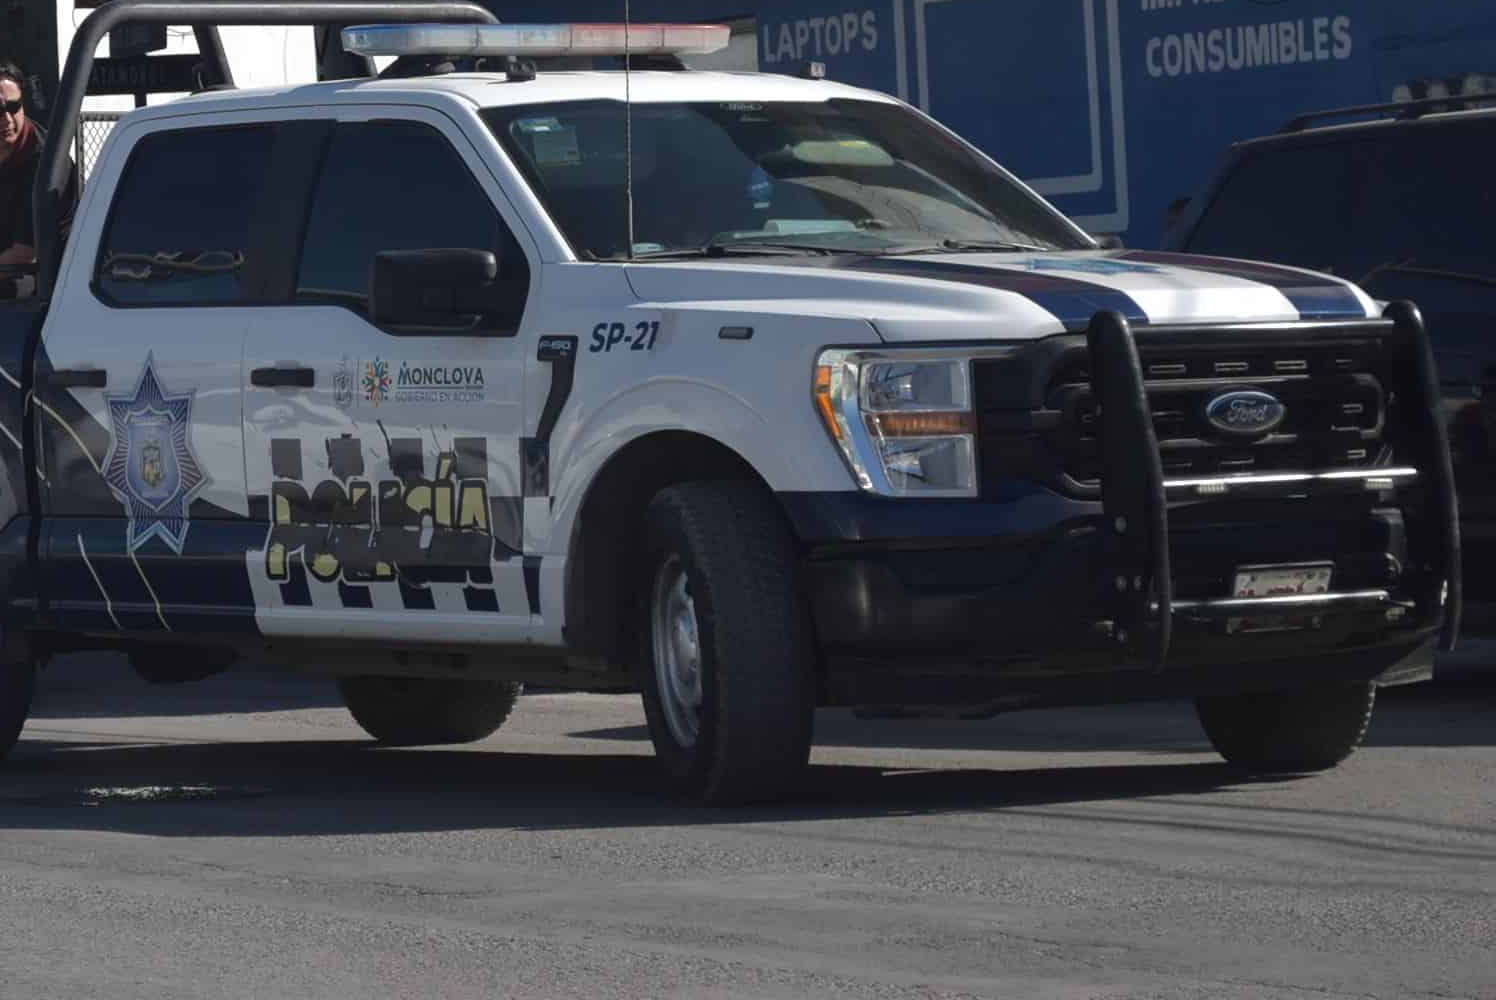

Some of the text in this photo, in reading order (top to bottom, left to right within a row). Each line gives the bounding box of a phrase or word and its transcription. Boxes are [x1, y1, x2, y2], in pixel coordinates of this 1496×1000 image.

[764, 10, 878, 64] LAPTOPS
[1145, 16, 1353, 78] CONSUMIBLES
[589, 320, 661, 353] SP-21
[397, 361, 485, 385] MONCLOVA
[1226, 399, 1269, 424] Ford
